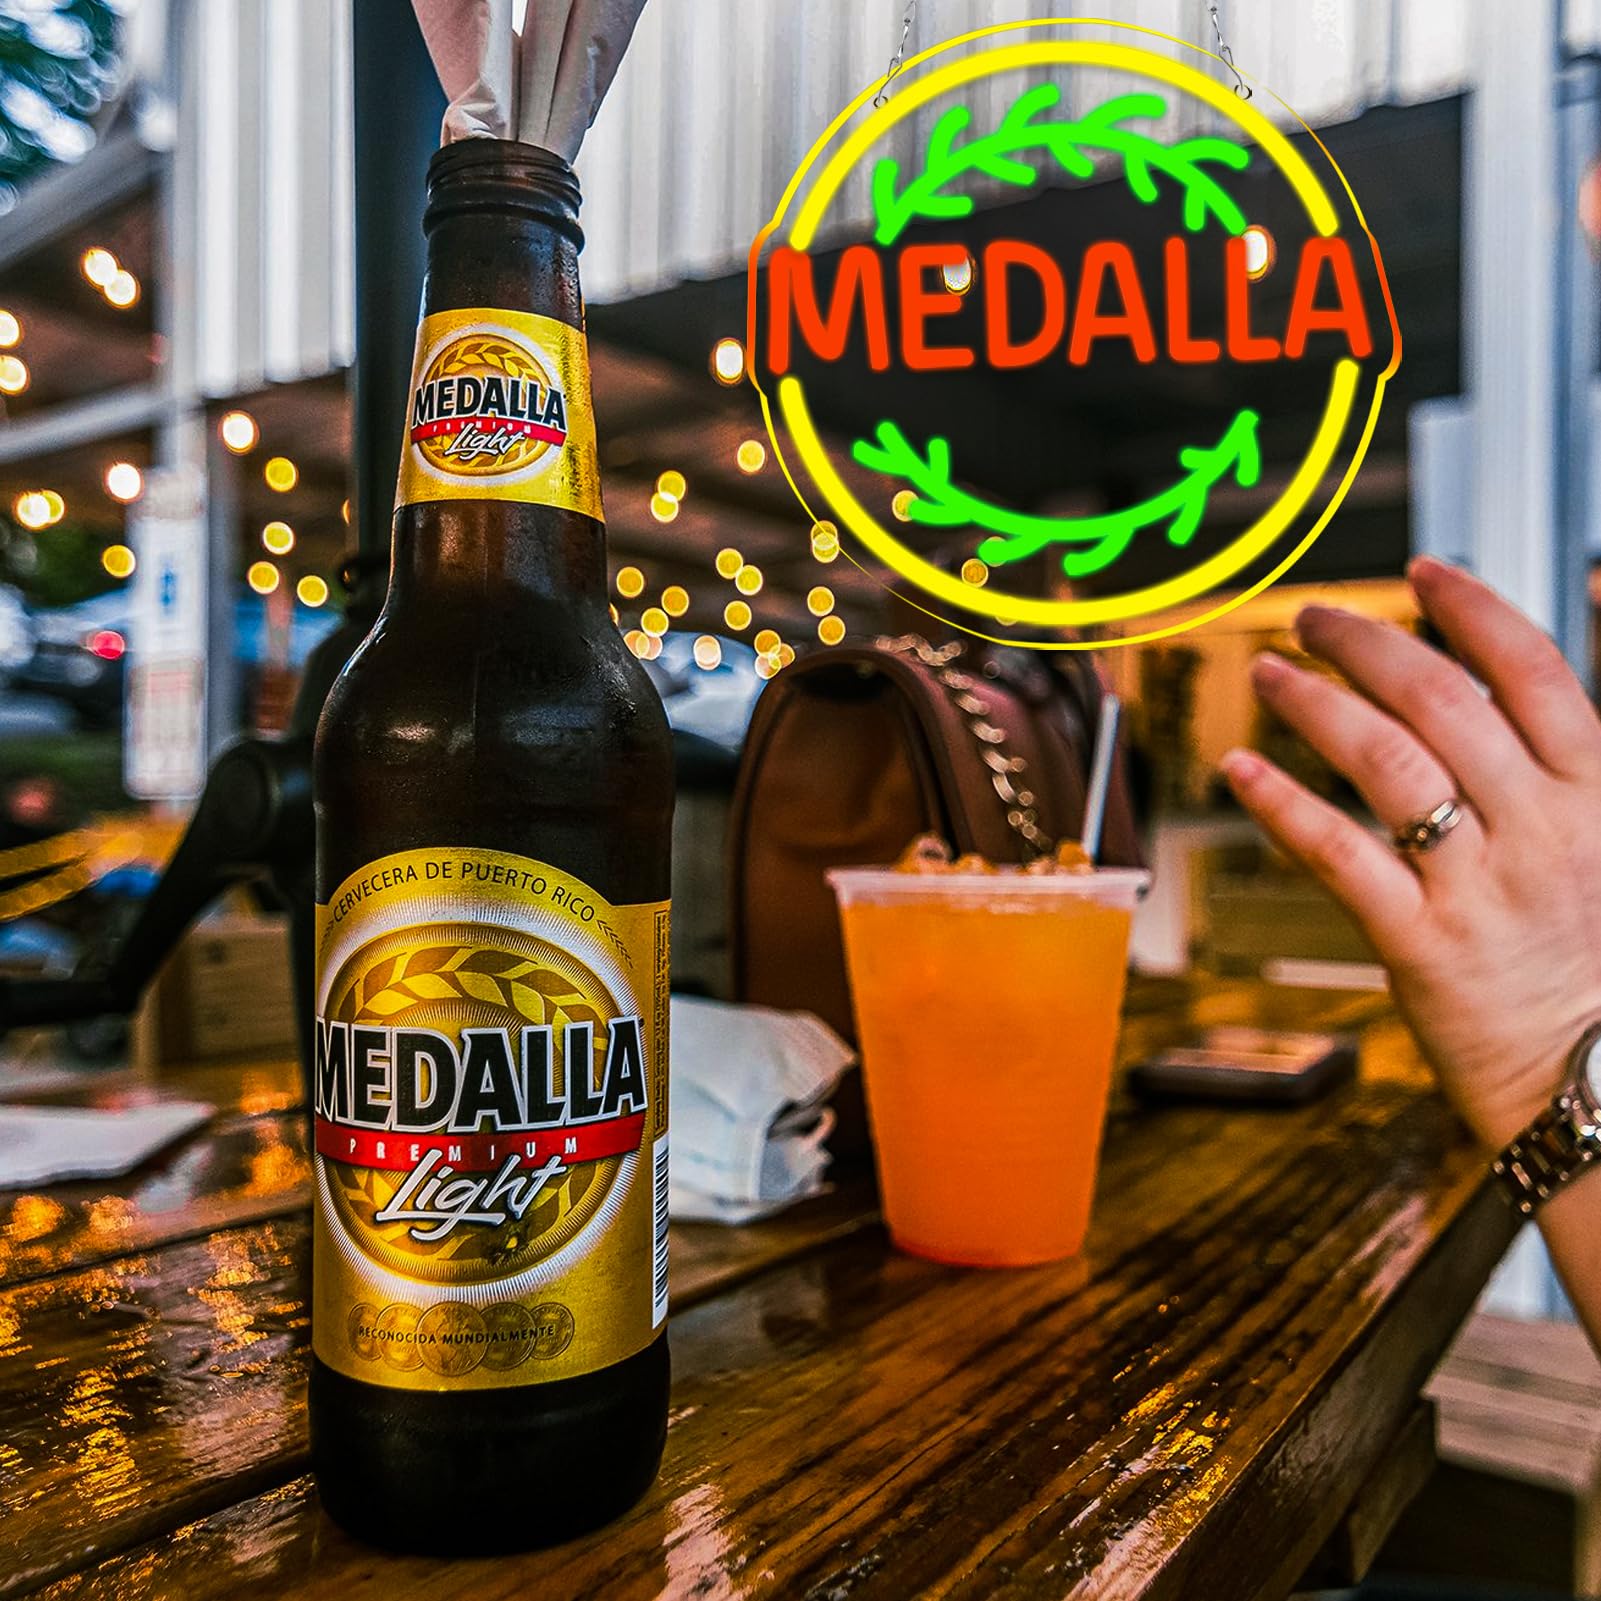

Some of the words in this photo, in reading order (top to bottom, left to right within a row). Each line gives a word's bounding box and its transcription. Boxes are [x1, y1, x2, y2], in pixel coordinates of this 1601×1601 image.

[769, 238, 1371, 373] MEDALLA
[413, 376, 567, 432] MEDALLA
[445, 423, 525, 459] Light
[332, 861, 418, 922] CERVECERA
[425, 861, 453, 880] DE
[461, 862, 547, 895] PUERTO
[551, 886, 596, 923] RICO
[316, 1015, 648, 1130] MEDALLA
[349, 1136, 578, 1162] PREMIUM
[376, 1149, 566, 1242] Light
[358, 1325, 437, 1345] RECONOCIDA
[442, 1325, 555, 1345] MUNDIALMENTE
